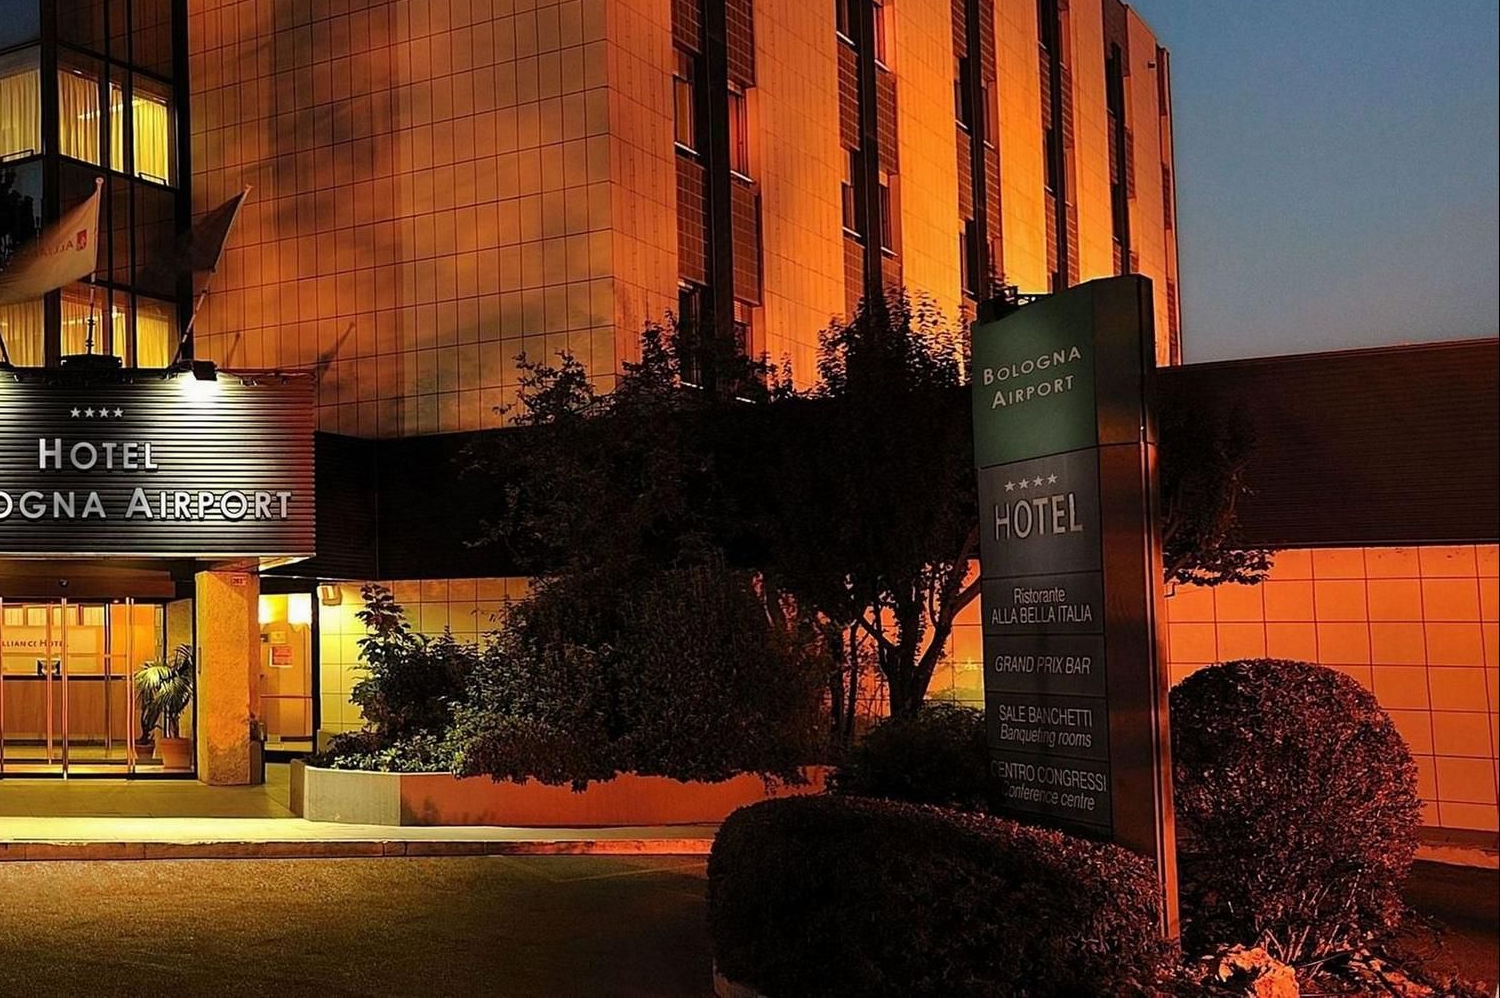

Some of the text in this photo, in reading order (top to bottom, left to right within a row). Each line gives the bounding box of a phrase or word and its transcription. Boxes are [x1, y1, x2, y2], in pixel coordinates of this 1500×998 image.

[983, 346, 1082, 386] BOLOGNA
[991, 375, 1075, 409] AIRPORT
[38, 438, 159, 471] HOTEL
[125, 487, 292, 520] AIRPORT
[994, 493, 1083, 541] HOTEL
[1013, 587, 1067, 604] Ristorante
[991, 603, 1093, 625] ALLA BELLA ITALIA
[39, 639, 68, 647] HOTE
[994, 655, 1091, 675] GRAND PRIX BAR
[998, 704, 1093, 727] SALE BANCHETTI
[1000, 723, 1093, 748] Banqueting rooms
[990, 759, 1107, 792] CENTRO CONGRESSI
[1004, 780, 1096, 811] Conference centre
